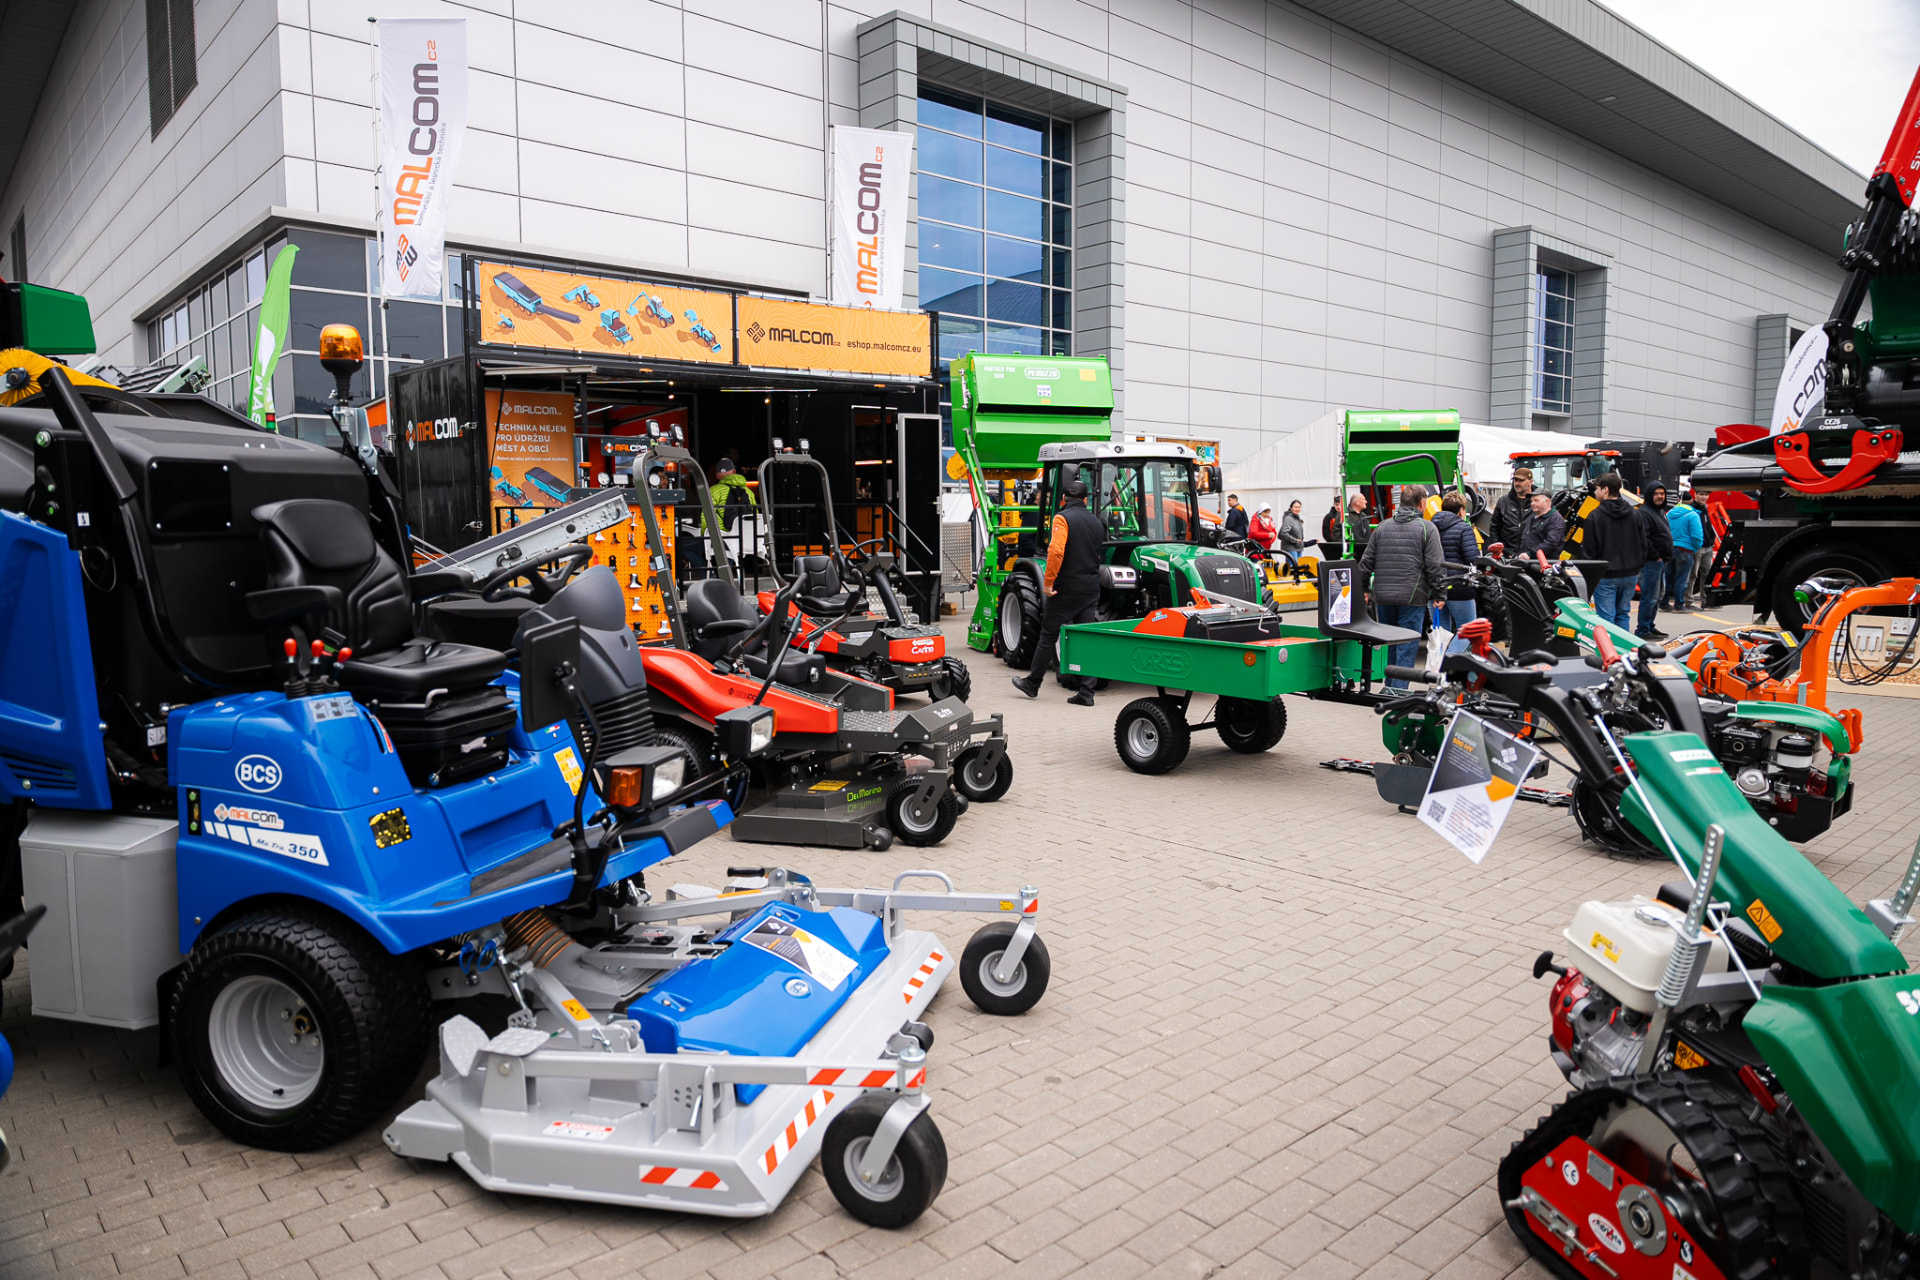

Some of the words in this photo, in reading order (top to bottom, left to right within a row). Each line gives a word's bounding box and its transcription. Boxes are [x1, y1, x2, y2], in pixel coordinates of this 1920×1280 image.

[393, 63, 439, 226] MALCOM
[414, 191, 434, 227] komunální
[429, 156, 442, 185] lesnická
[436, 122, 447, 155] technika
[856, 162, 883, 295] MALCOM
[769, 327, 834, 346] MALCOM
[847, 339, 922, 353] eshop.malcomcz.eu
[514, 405, 557, 415] MALCOM
[417, 417, 458, 442] MALCOM
[496, 434, 512, 442] PRO
[514, 433, 551, 443] ÚDRŽBU
[496, 443, 518, 452] MĚST
[527, 445, 549, 453] OBCÍ
[240, 763, 277, 785] BCS
[229, 808, 277, 824] MALCOM
[288, 843, 319, 859] 350
